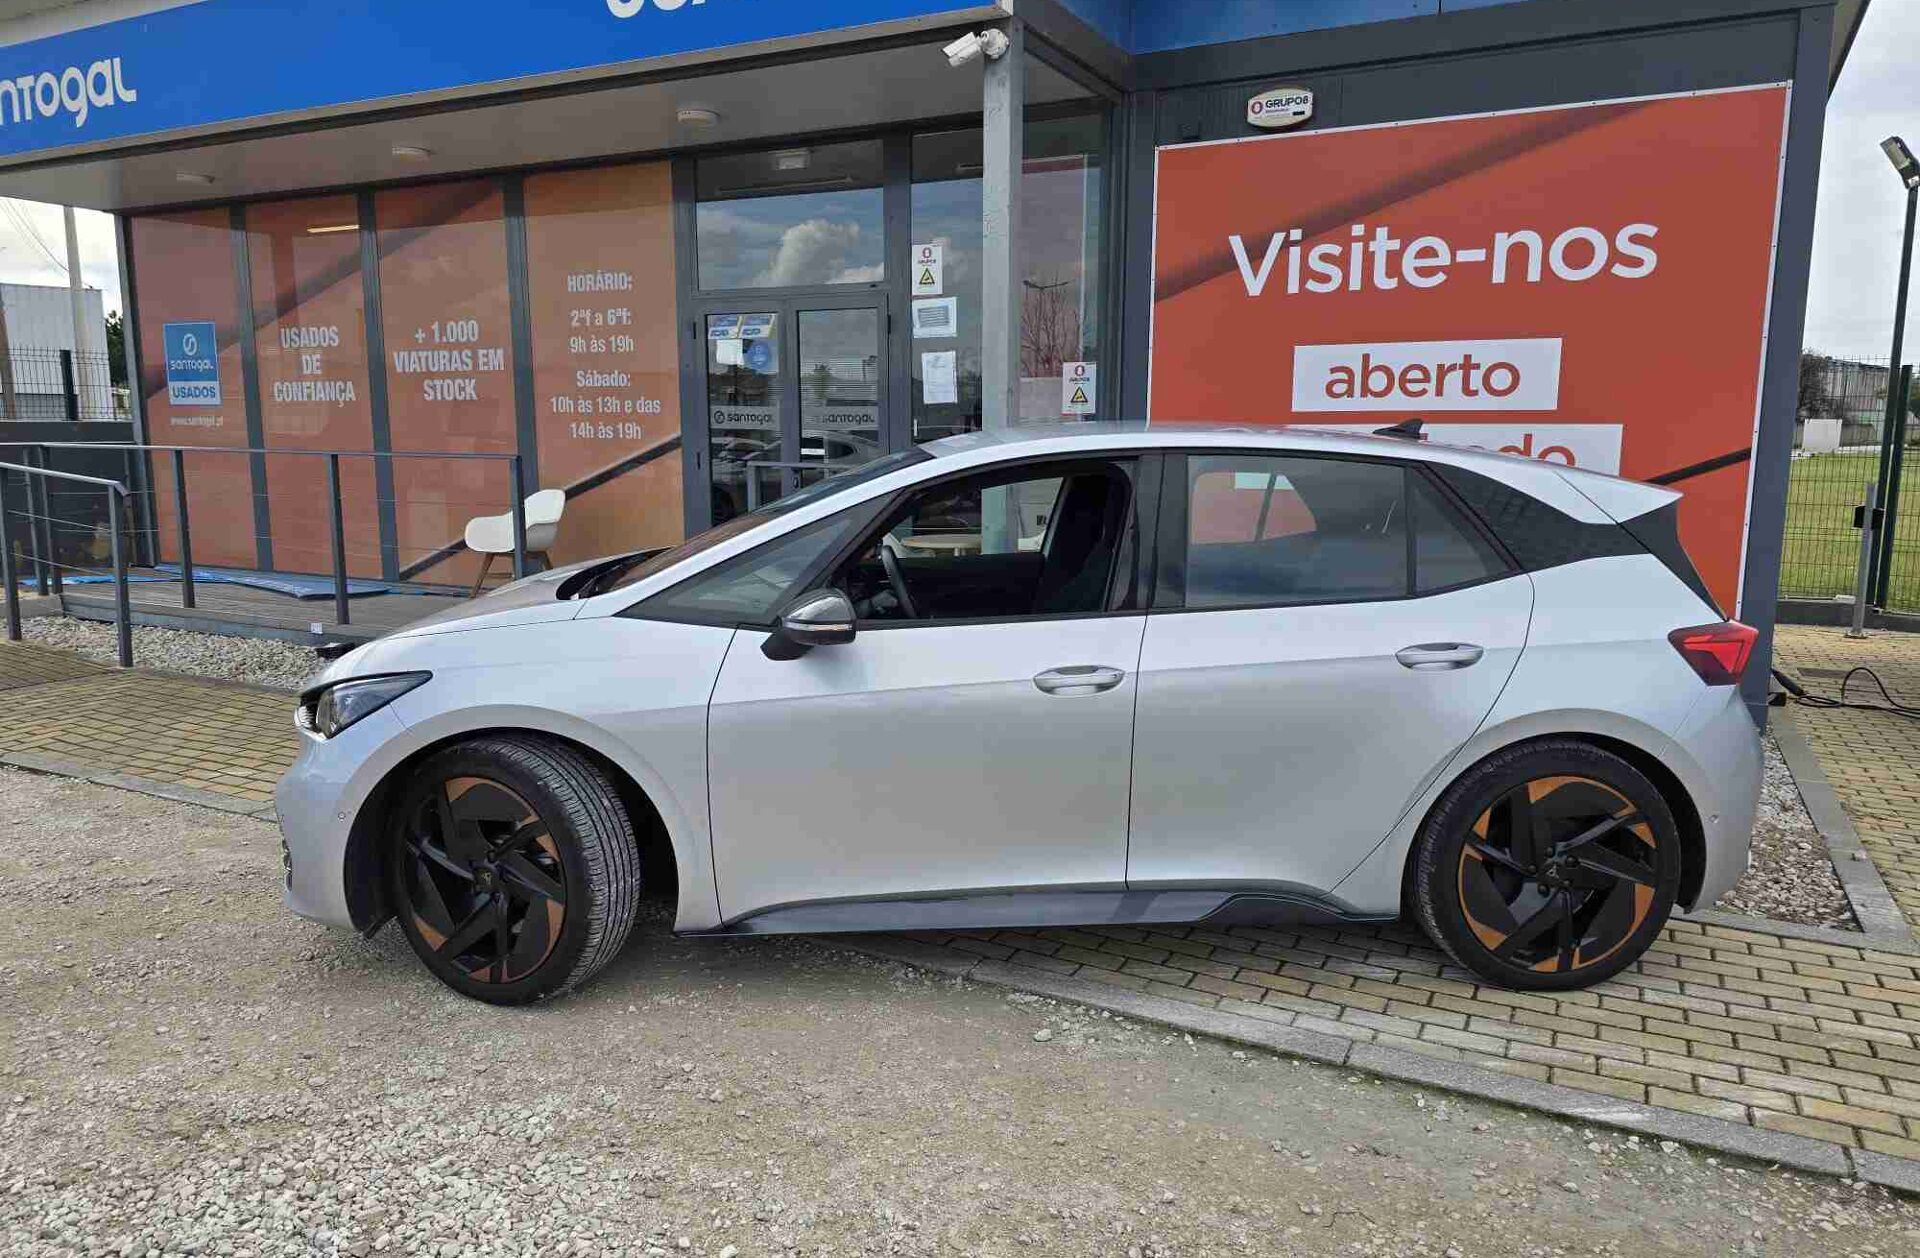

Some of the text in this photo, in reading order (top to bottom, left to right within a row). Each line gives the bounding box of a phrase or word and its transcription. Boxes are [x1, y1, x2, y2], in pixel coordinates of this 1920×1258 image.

[1266, 96, 1308, 109] GRUPO8
[1228, 223, 1659, 297] Visite-nos
[567, 269, 632, 292] HORÁRIO:
[595, 312, 603, 325] a
[280, 326, 339, 348] USADOS
[415, 320, 479, 343] + 1.000
[570, 334, 634, 353] 9h às 19h
[302, 354, 322, 374] DE
[393, 348, 505, 372] VIATURAS EM
[576, 370, 631, 387] Sábado:
[1324, 353, 1521, 399] aberto
[172, 386, 216, 398] USADOS
[273, 381, 357, 408] CONFIANÇA
[424, 379, 478, 400] STOCK
[551, 395, 661, 413] 10h às 13h e das
[570, 421, 641, 439] 14h às 19h
